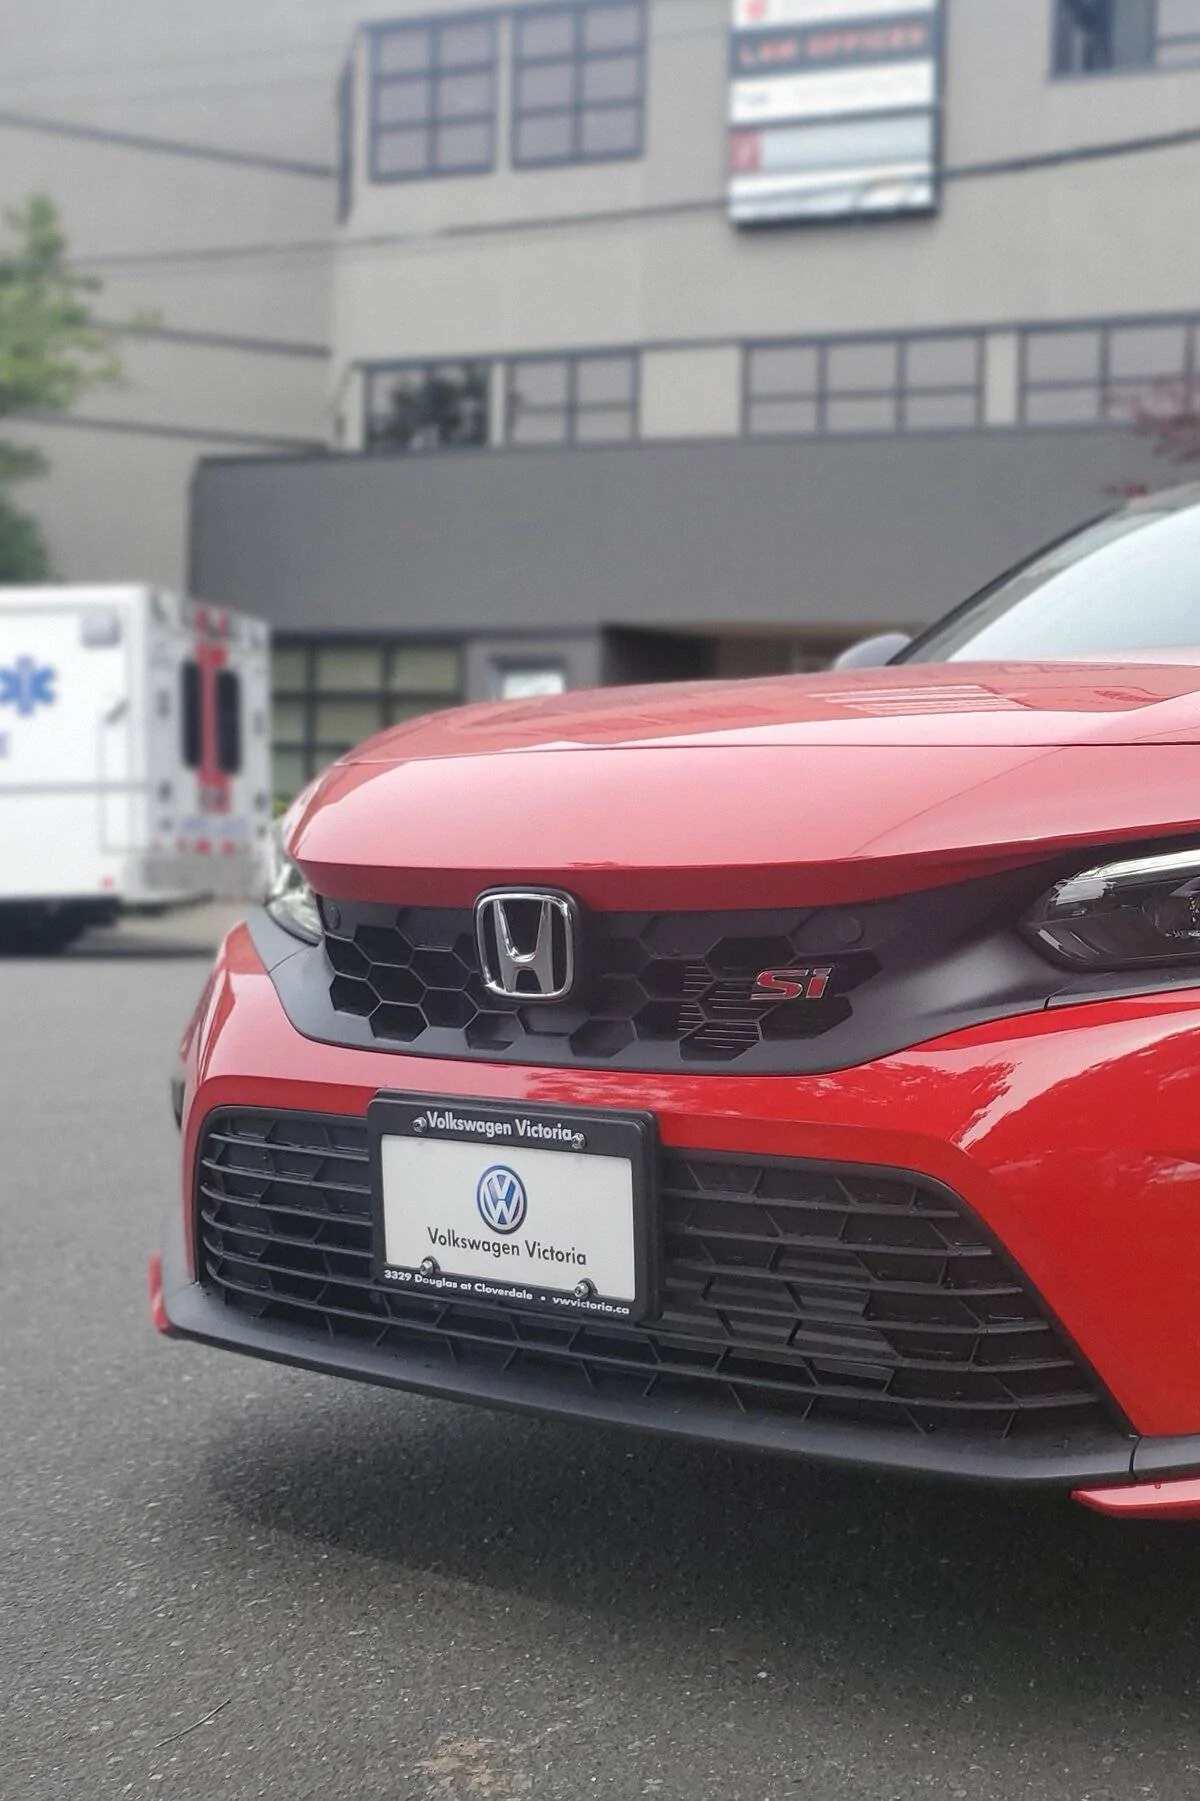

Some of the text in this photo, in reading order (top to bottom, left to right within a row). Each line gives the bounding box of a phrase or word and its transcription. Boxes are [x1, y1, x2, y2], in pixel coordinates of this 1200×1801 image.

[750, 966, 834, 1000] Si
[426, 1111, 573, 1141] Volkswagen Victoria
[427, 1227, 587, 1265] Volkswagen Victoria
[384, 1269, 630, 1314] 3329 Douglas at Cloverdale vwvictoria.ca
